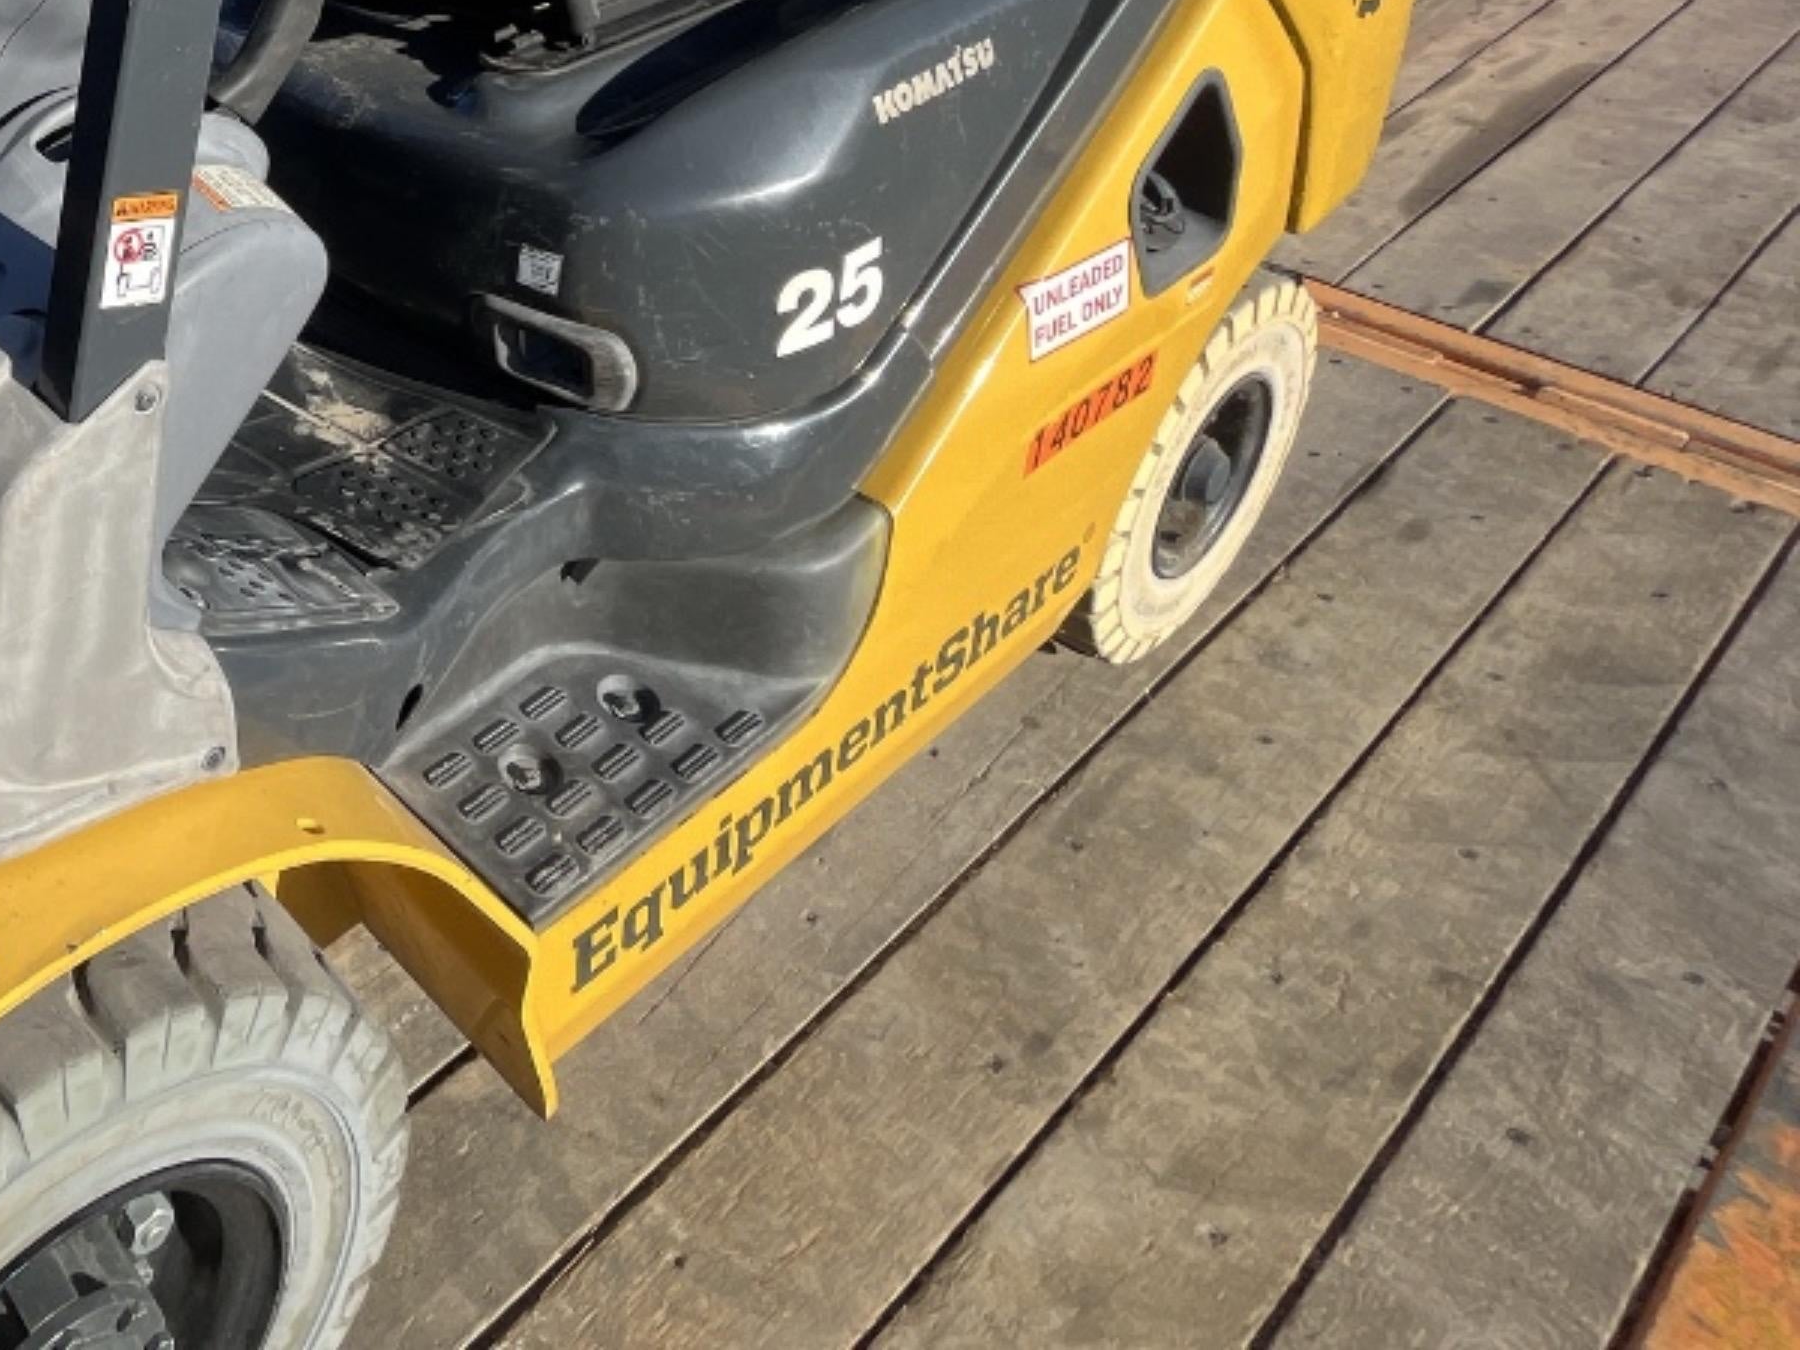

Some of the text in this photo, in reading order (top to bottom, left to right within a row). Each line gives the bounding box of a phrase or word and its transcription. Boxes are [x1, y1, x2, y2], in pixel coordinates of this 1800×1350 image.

[872, 36, 995, 125] KOMATSU
[776, 237, 884, 358] 25
[1032, 253, 1124, 317] UNLEADED
[1034, 284, 1124, 349] FUEL ONLY
[1031, 354, 1155, 470] 140782
[570, 545, 1081, 993] EquipmentShare
